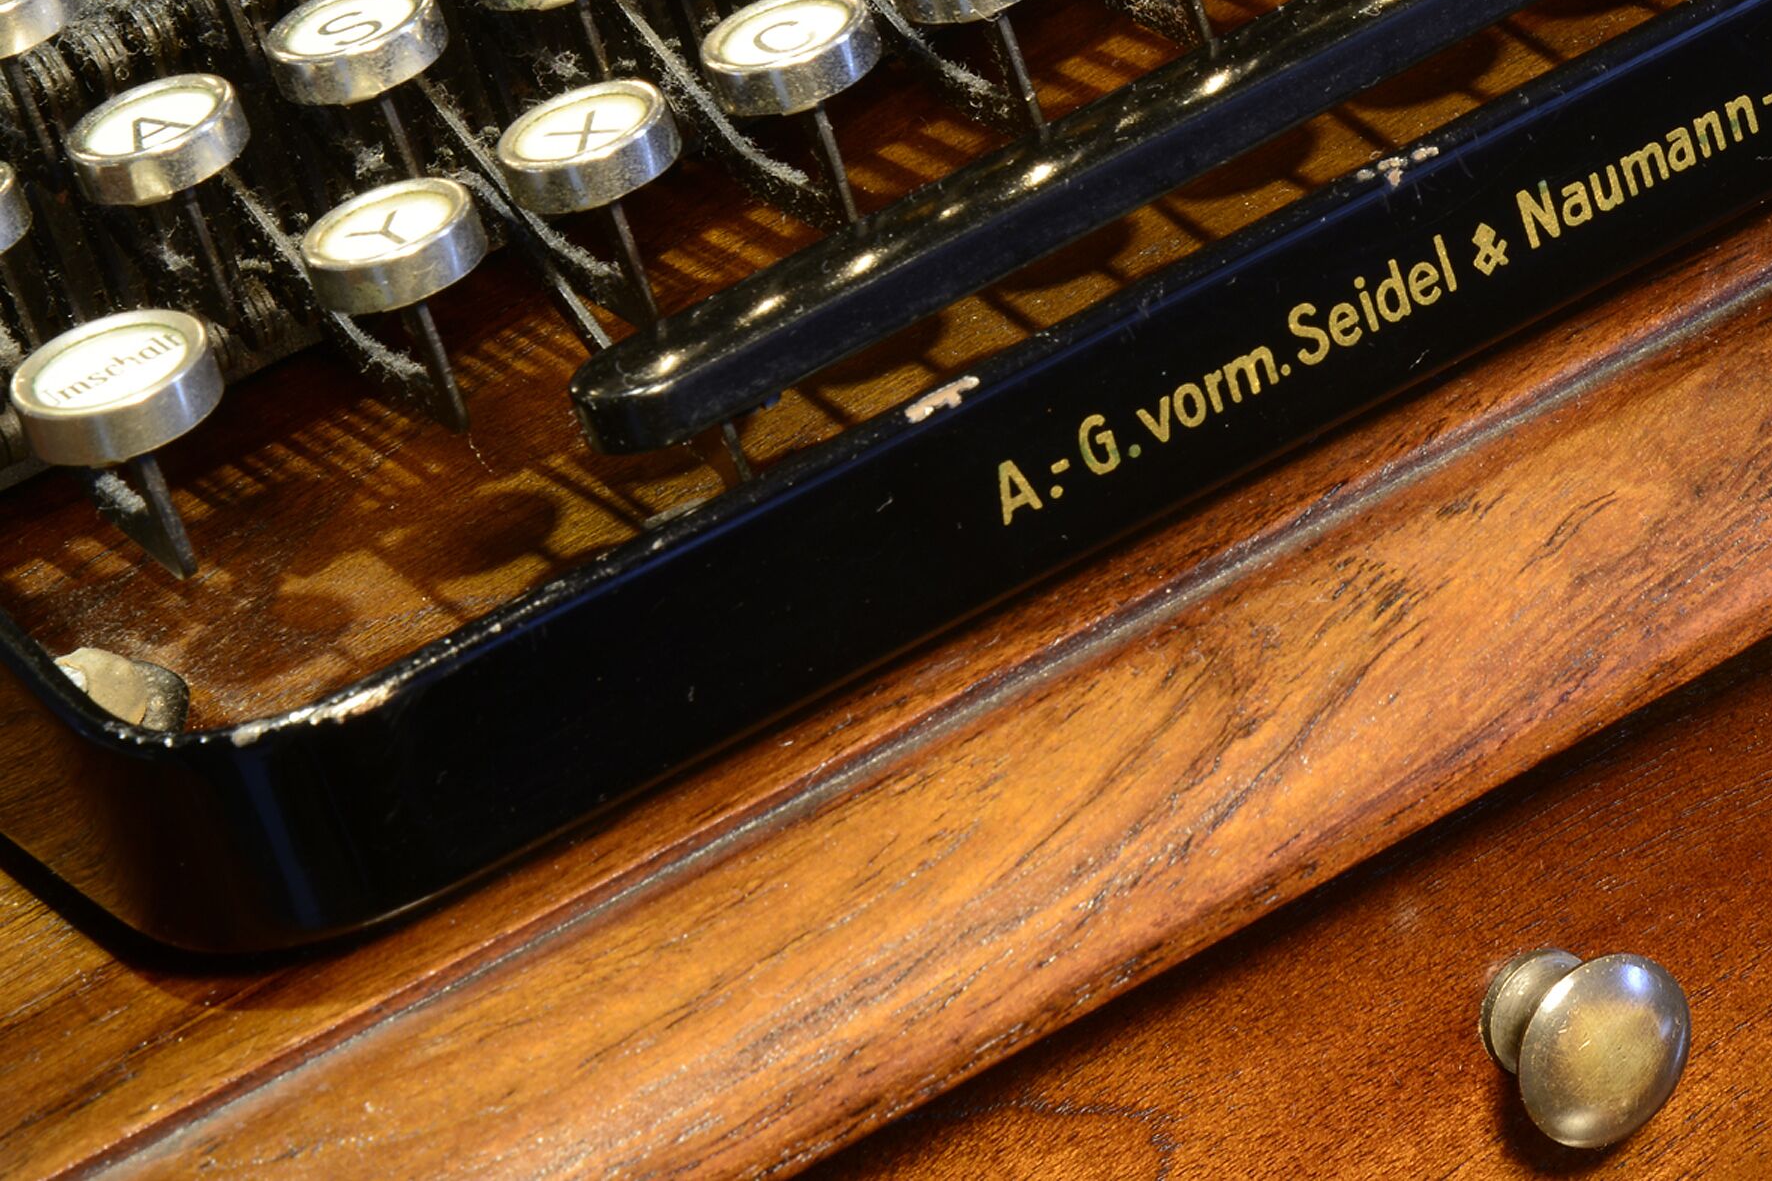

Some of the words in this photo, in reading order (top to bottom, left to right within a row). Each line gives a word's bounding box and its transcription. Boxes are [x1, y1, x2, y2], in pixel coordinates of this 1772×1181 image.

[318, 12, 384, 47] S
[752, 21, 815, 53] C
[132, 116, 191, 154] A
[545, 110, 621, 154] X
[348, 211, 406, 246] Y
[1136, 346, 1292, 443] vorm.
[1288, 234, 1458, 366] Seidel
[1472, 222, 1509, 276] &
